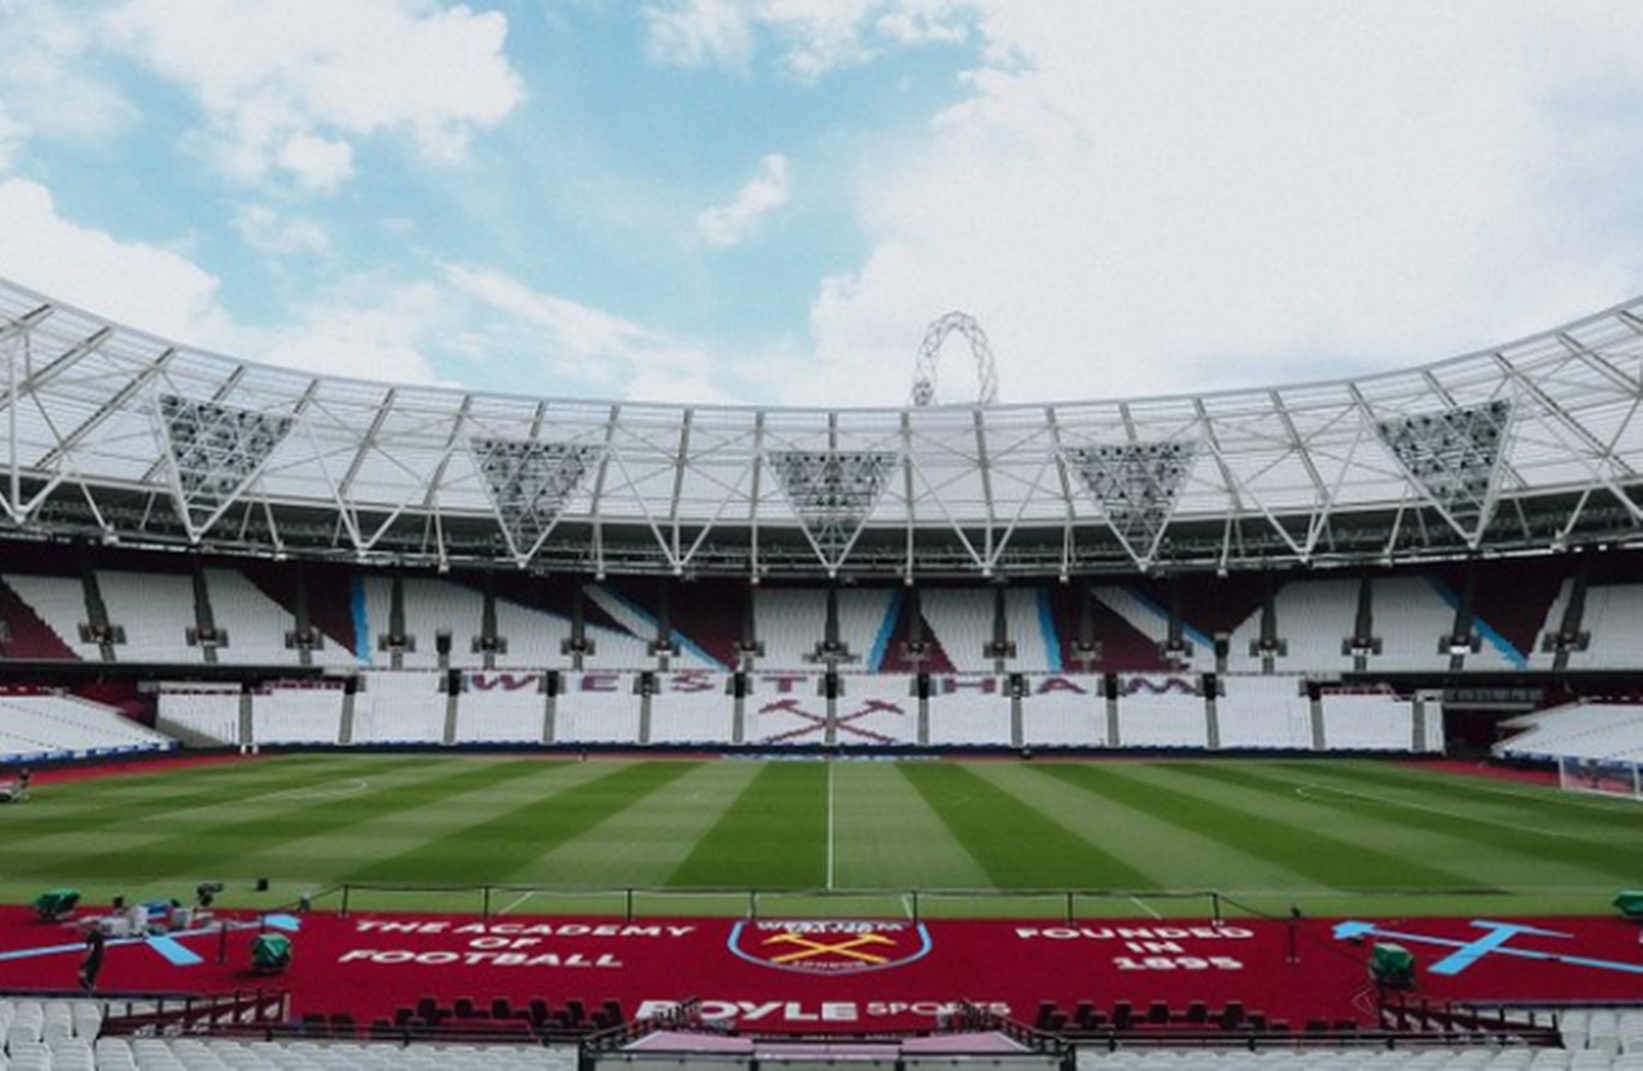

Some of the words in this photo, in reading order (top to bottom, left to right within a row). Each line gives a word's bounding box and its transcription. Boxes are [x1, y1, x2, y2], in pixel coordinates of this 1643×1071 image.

[471, 673, 808, 692] WEST
[942, 678, 1197, 696] HAM
[355, 921, 450, 933] THE
[453, 923, 695, 936] ACADEMY
[1015, 928, 1254, 939] FOUNDED
[469, 936, 543, 949] OF
[1125, 941, 1184, 953] IN
[338, 949, 623, 967] FOOTBALL
[1112, 956, 1243, 970] 1895
